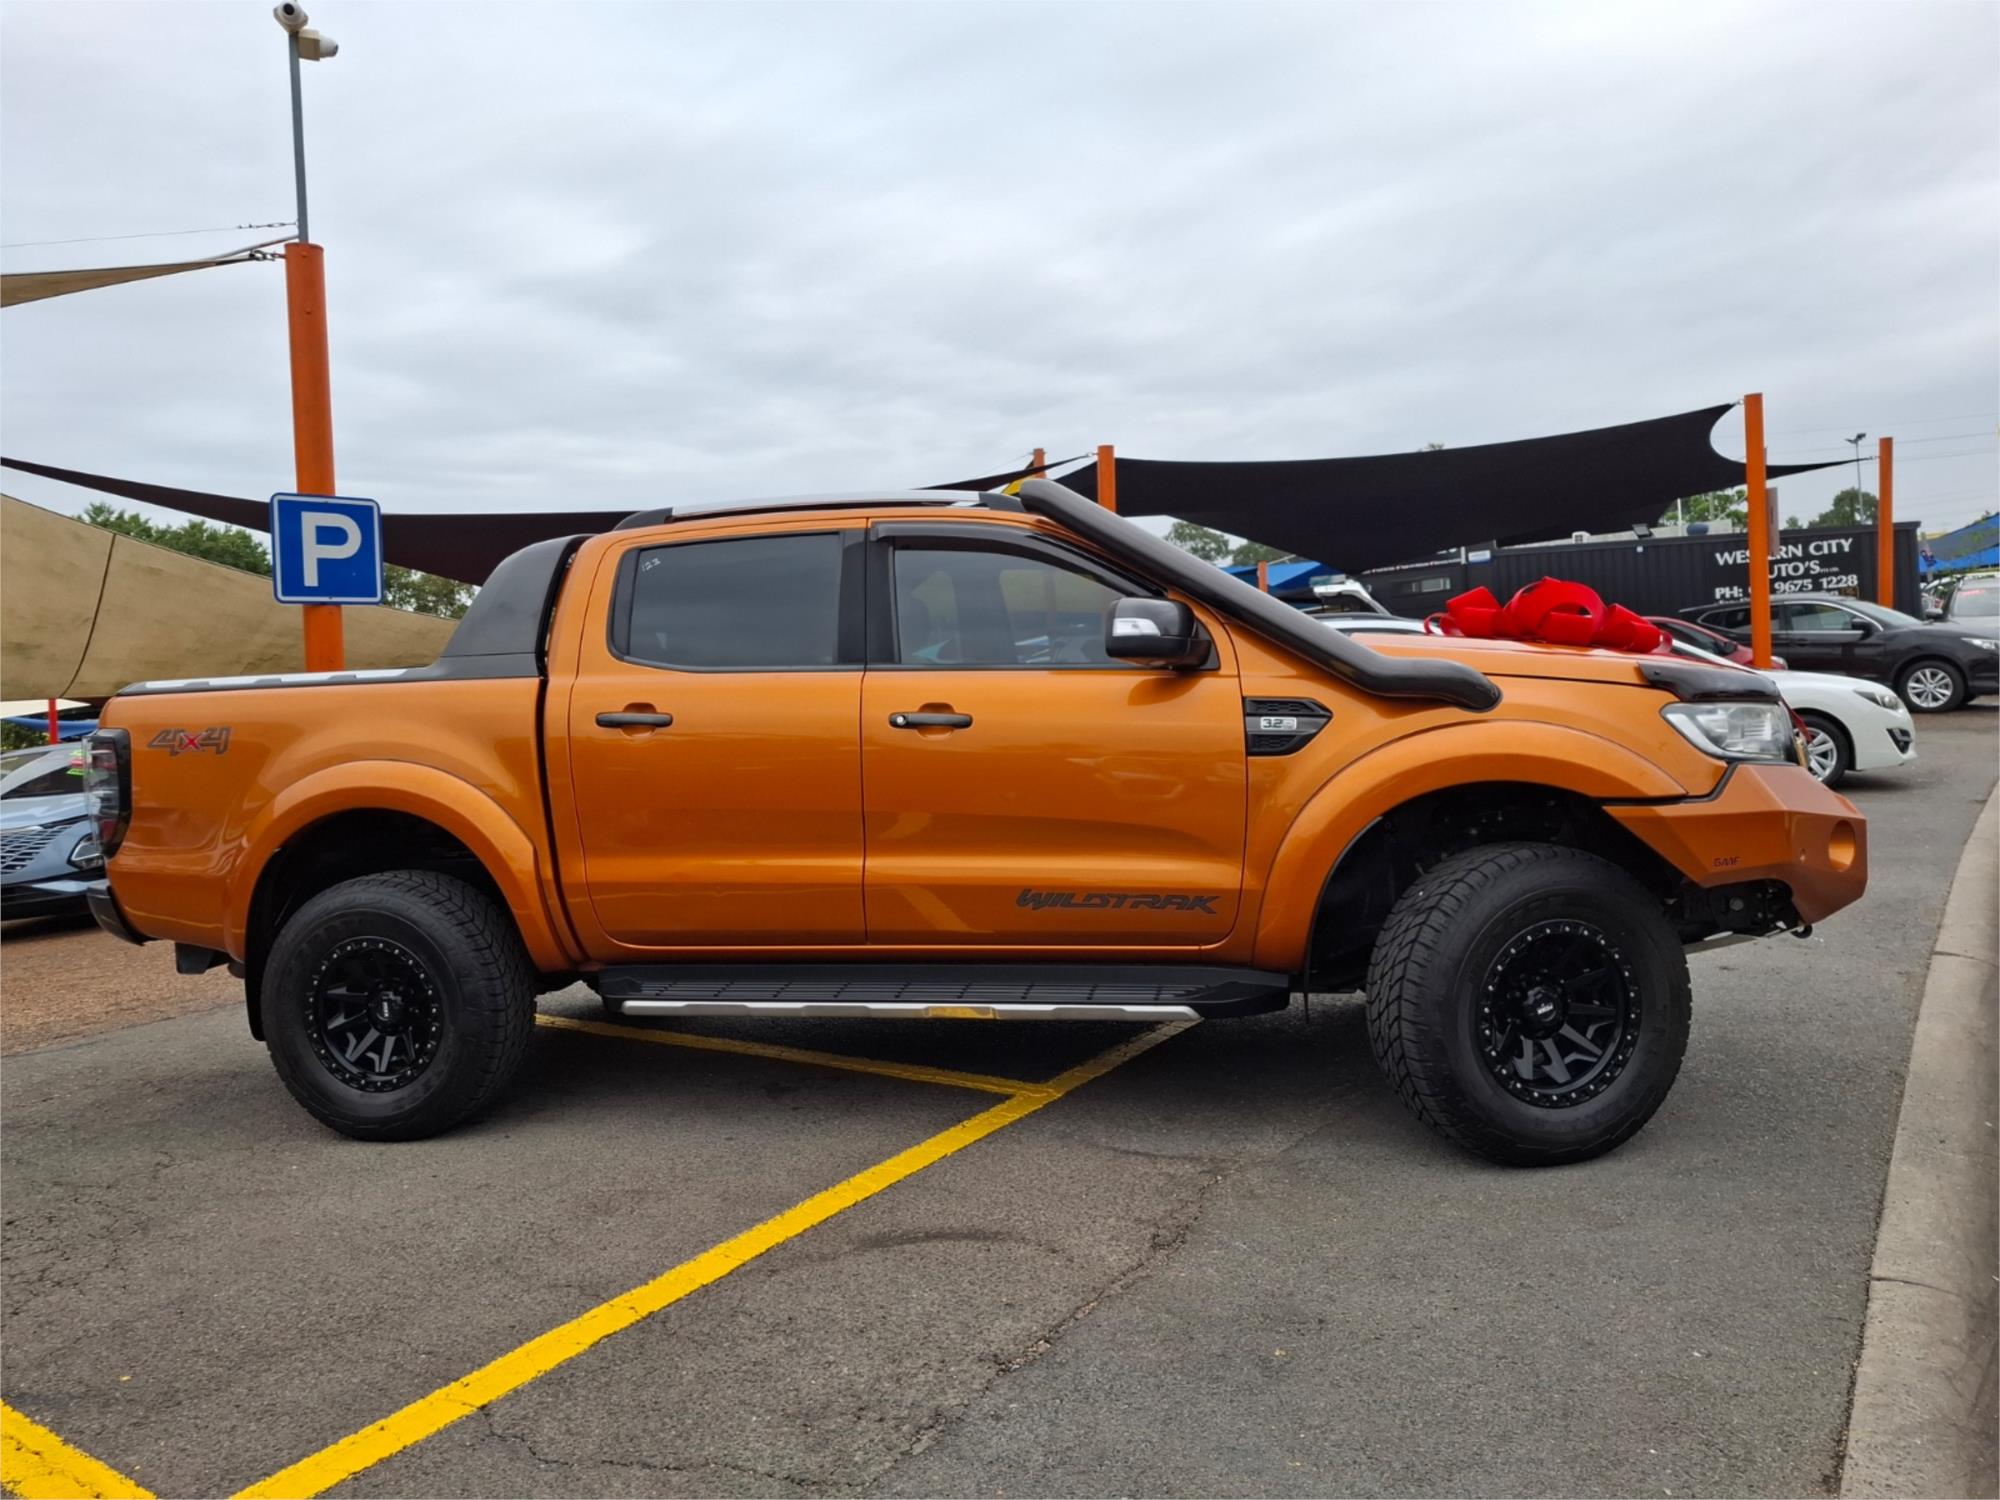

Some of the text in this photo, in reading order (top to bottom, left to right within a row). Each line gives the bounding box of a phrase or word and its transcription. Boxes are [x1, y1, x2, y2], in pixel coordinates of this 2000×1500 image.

[301, 511, 362, 587] P
[1715, 538, 1853, 566] WERN CITY
[1768, 560, 1820, 578] UTO'S
[1715, 585, 1743, 599] PH:
[1774, 579, 1812, 594] 9675
[1819, 574, 1858, 589] 1228
[1016, 888, 1220, 914] WILDTRAK
